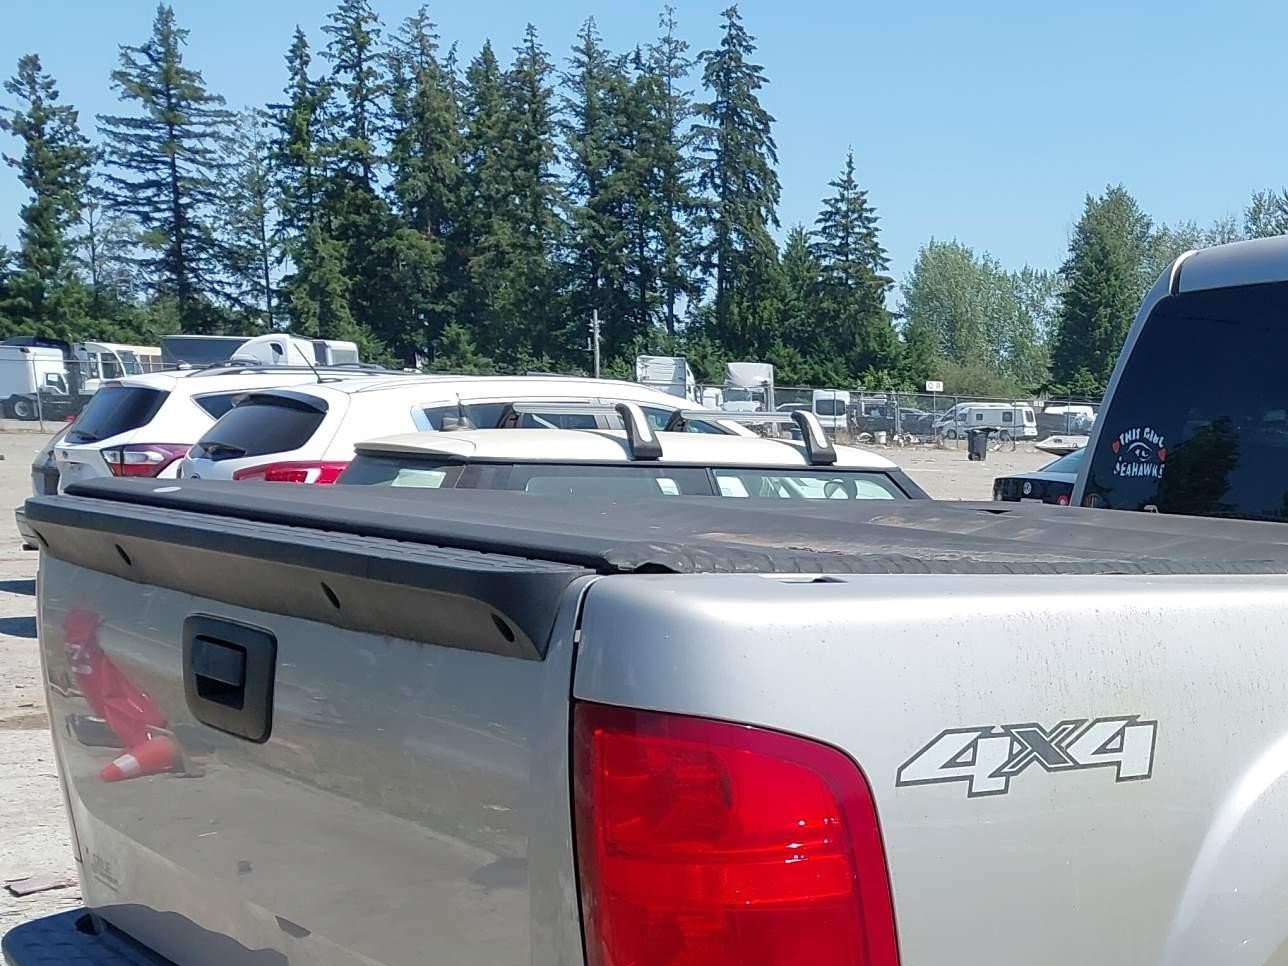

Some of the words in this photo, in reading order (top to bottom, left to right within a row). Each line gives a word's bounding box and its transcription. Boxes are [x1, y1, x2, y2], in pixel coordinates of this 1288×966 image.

[1120, 428, 1140, 446] THIS
[1143, 427, 1164, 448] GIRL
[1113, 456, 1165, 478] SEAHAWKS
